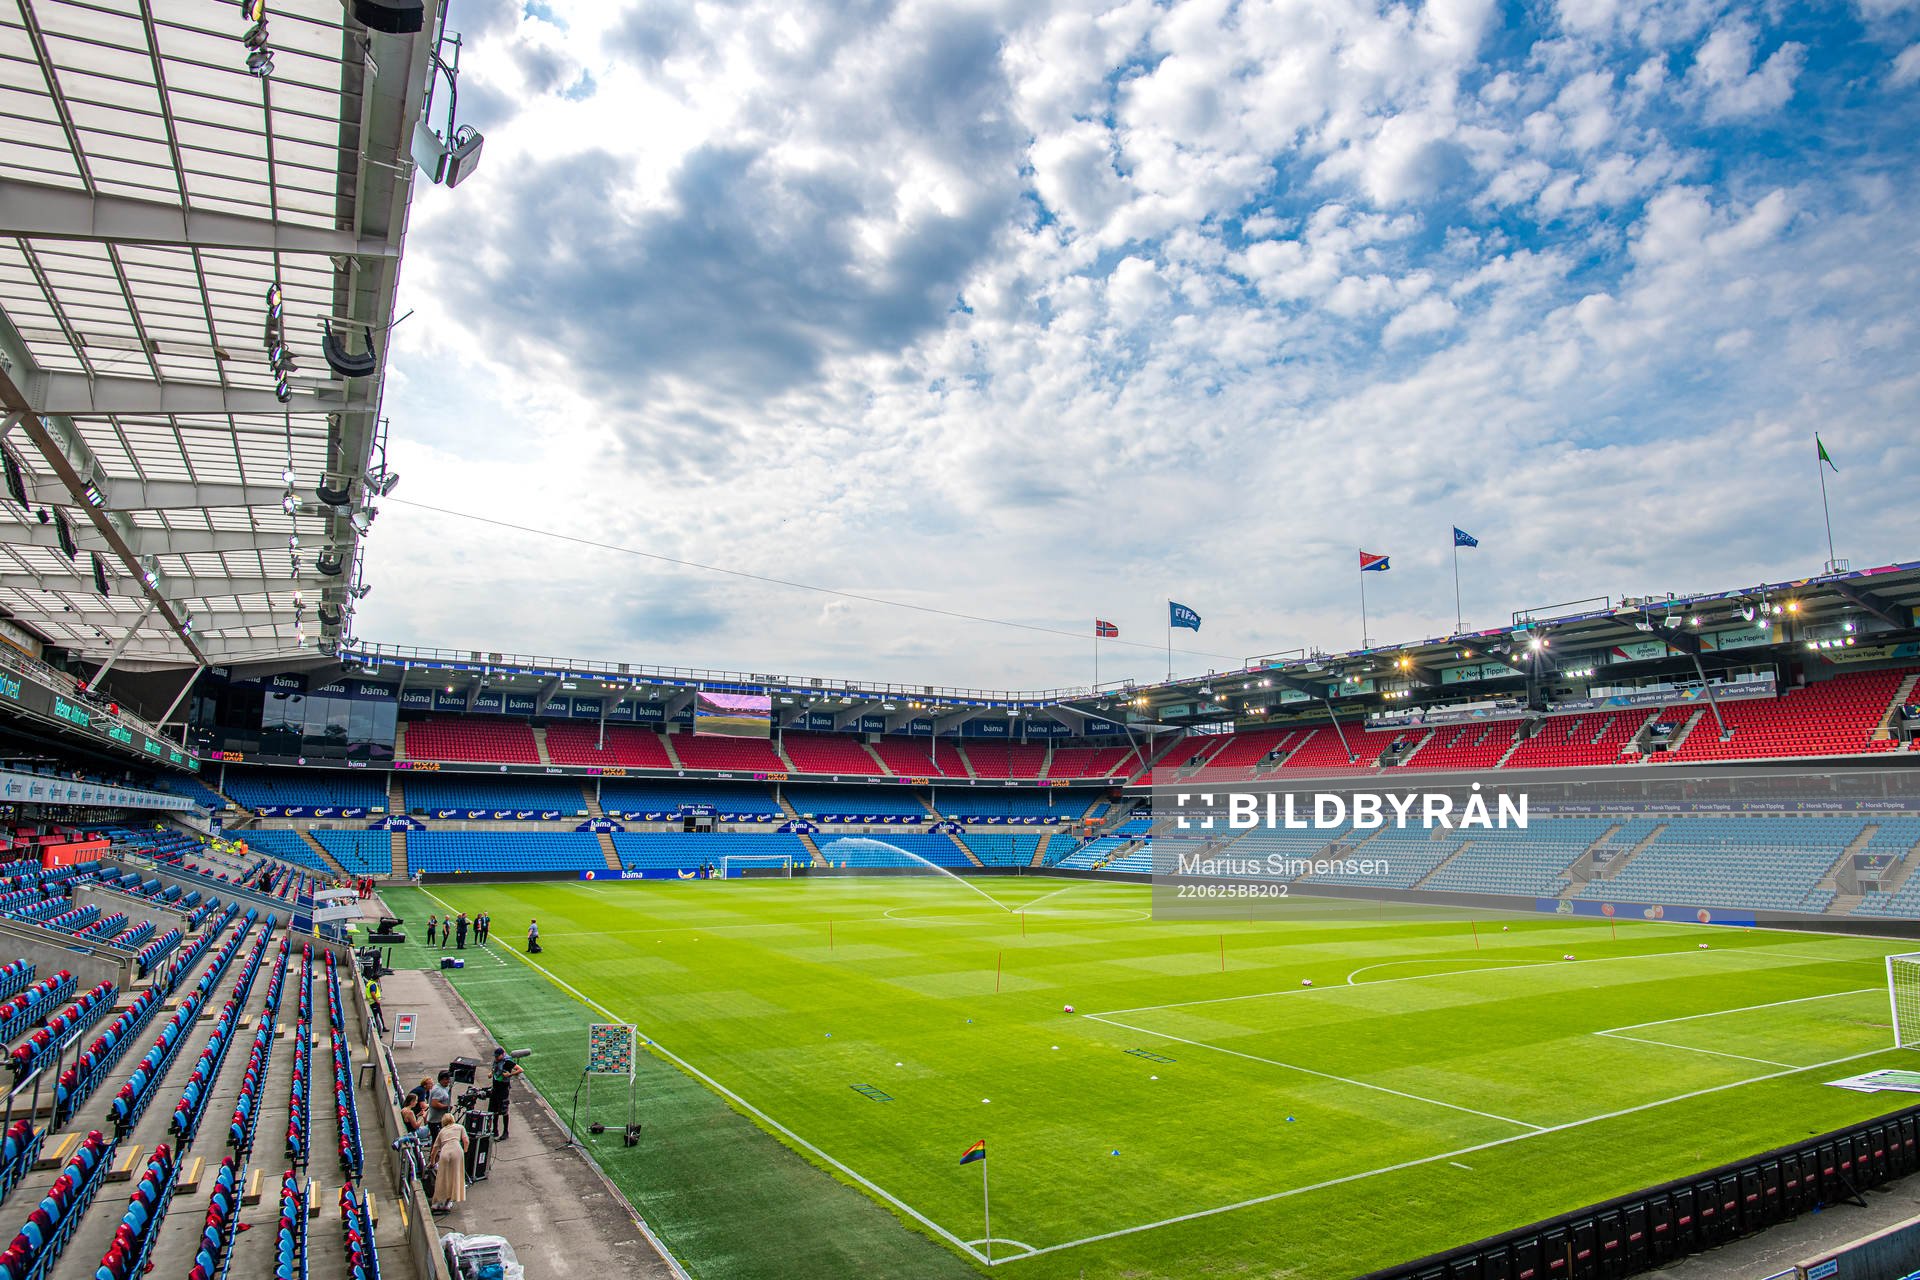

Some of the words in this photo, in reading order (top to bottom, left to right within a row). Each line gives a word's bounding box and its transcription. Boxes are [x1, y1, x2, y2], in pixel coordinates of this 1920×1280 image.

[1175, 608, 1197, 622] FIFA
[1726, 636, 1742, 644] Norsk
[1744, 634, 1766, 642] Tipping
[1486, 666, 1510, 676] Tipping
[273, 676, 299, 688] bama
[360, 685, 389, 696] bama
[1744, 685, 1766, 693] Tipping
[403, 693, 430, 703] bama
[439, 696, 465, 706] bama
[510, 700, 534, 709] bama
[576, 703, 600, 713] bama
[640, 708, 662, 717] bama
[812, 716, 831, 726] bama
[864, 719, 883, 729] bama
[1092, 721, 1110, 731] bama
[913, 722, 931, 731] bama
[984, 722, 1003, 733] bama
[1028, 722, 1047, 733] bama
[1053, 724, 1069, 732] bama
[386, 818, 410, 826] bama
[590, 820, 610, 828] bama
[622, 870, 642, 879] bama
